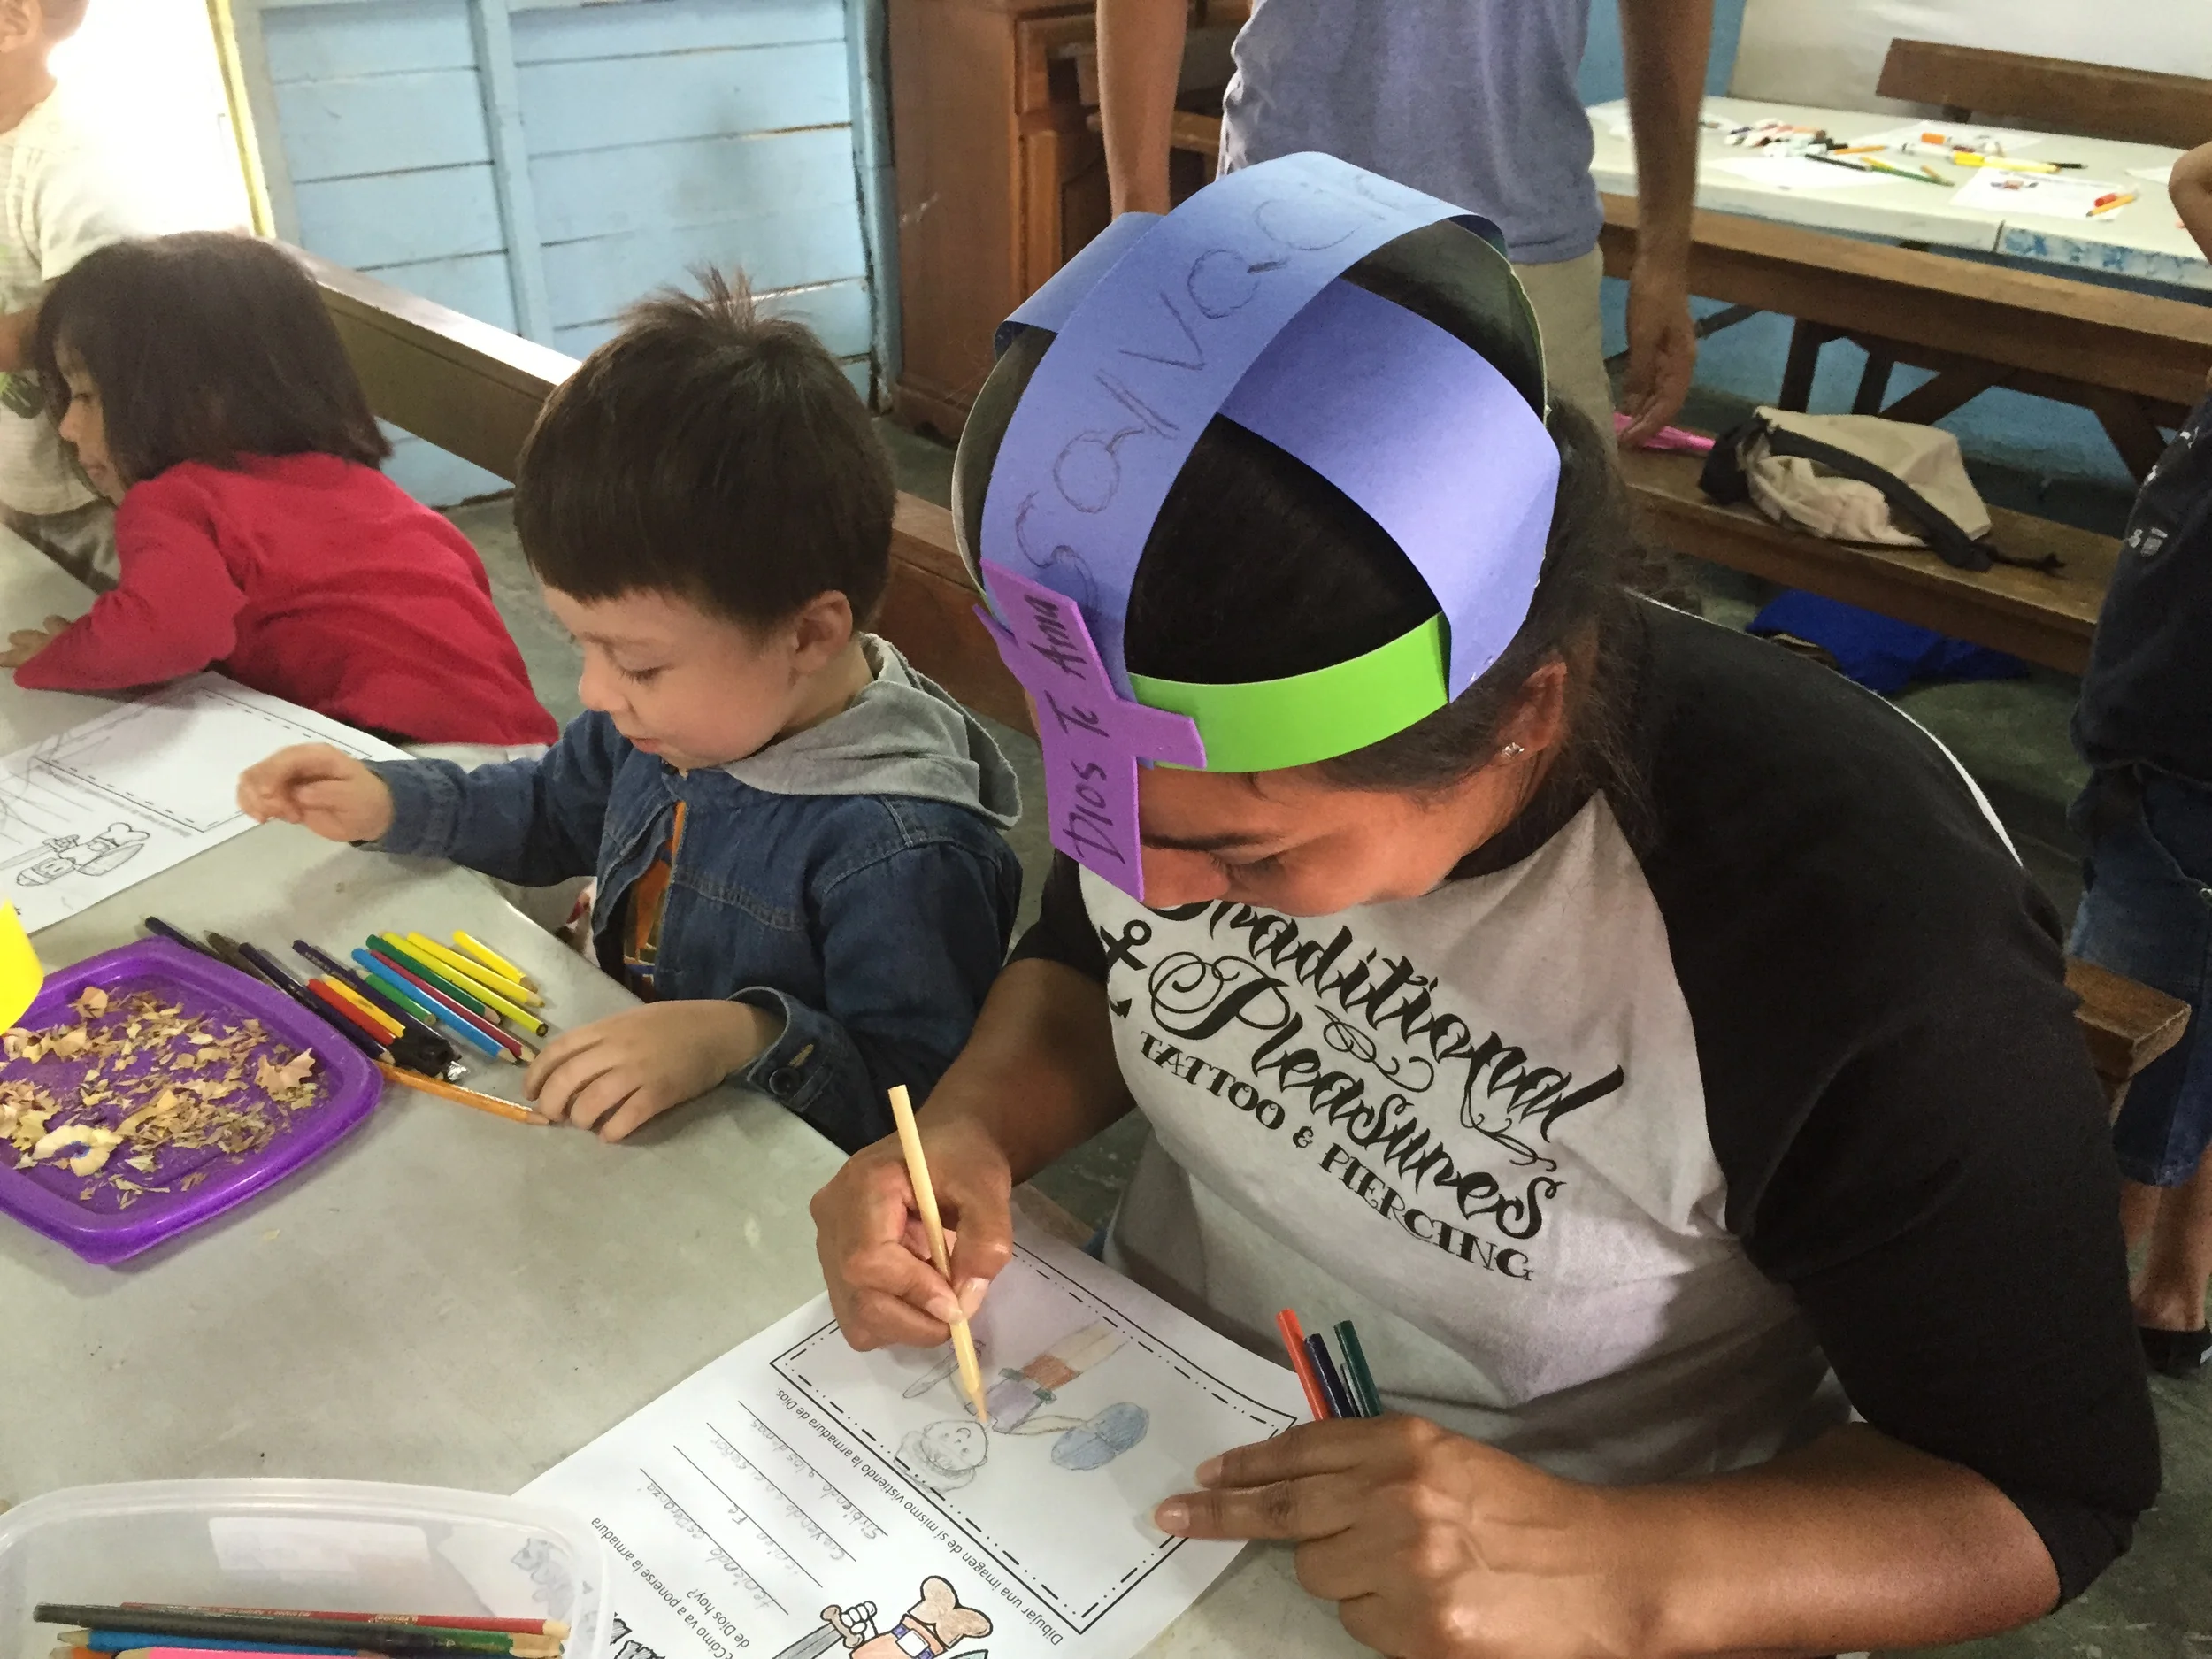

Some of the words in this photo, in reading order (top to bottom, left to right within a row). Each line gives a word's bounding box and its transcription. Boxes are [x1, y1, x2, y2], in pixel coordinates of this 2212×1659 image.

[1025, 594, 1087, 680] Ama
[1148, 951, 1566, 1239] Pleasures
[1140, 1030, 1286, 1132] TATTOO
[1292, 1125, 1316, 1149] &
[1318, 1142, 1533, 1281] PIERCING
[795, 1406, 810, 1420] de
[807, 1417, 854, 1457] armadura
[850, 1454, 864, 1468] la
[859, 1463, 905, 1504] vistiendo
[902, 1500, 939, 1532] mismo
[589, 1517, 634, 1562] armadura
[946, 1538, 964, 1554] de
[630, 1558, 644, 1573] la
[960, 1551, 1002, 1592] imagen
[640, 1567, 683, 1608] ponerse
[685, 1587, 716, 1616] hoy?
[999, 1586, 1023, 1609] una
[675, 1605, 687, 1616] a
[683, 1612, 699, 1630] va
[710, 1610, 737, 1637] Dios
[733, 1632, 750, 1648] de
[1019, 1606, 1064, 1646] Dibujar
